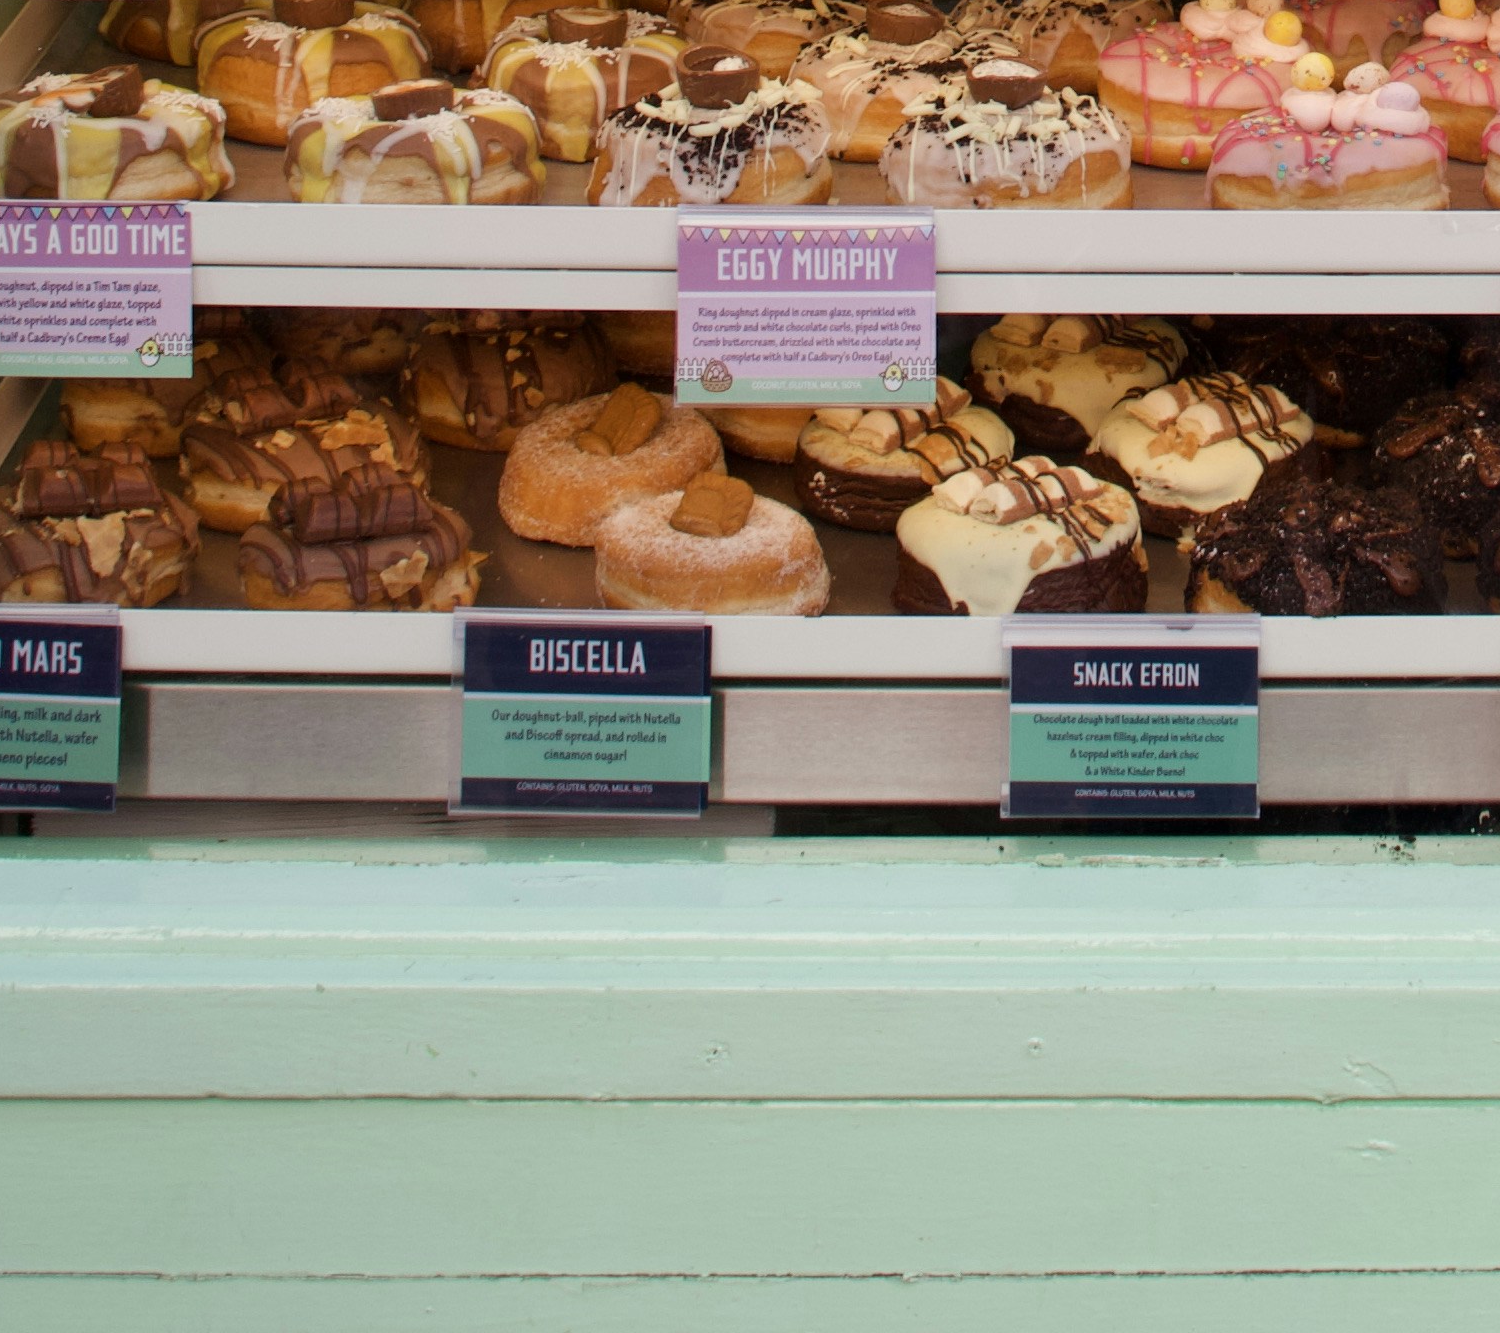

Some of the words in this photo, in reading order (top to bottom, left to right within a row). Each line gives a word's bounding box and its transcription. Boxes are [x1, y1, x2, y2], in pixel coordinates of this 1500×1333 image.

[46, 223, 61, 254] A
[70, 223, 117, 254] GOO
[125, 223, 185, 254] TIME
[717, 248, 782, 280] EGGY
[792, 247, 897, 280] MURPHY
[12, 639, 82, 674] MARS
[530, 639, 645, 674] BISCELLA
[1073, 661, 1132, 685] SNACK
[1140, 662, 1199, 686] EFRON
